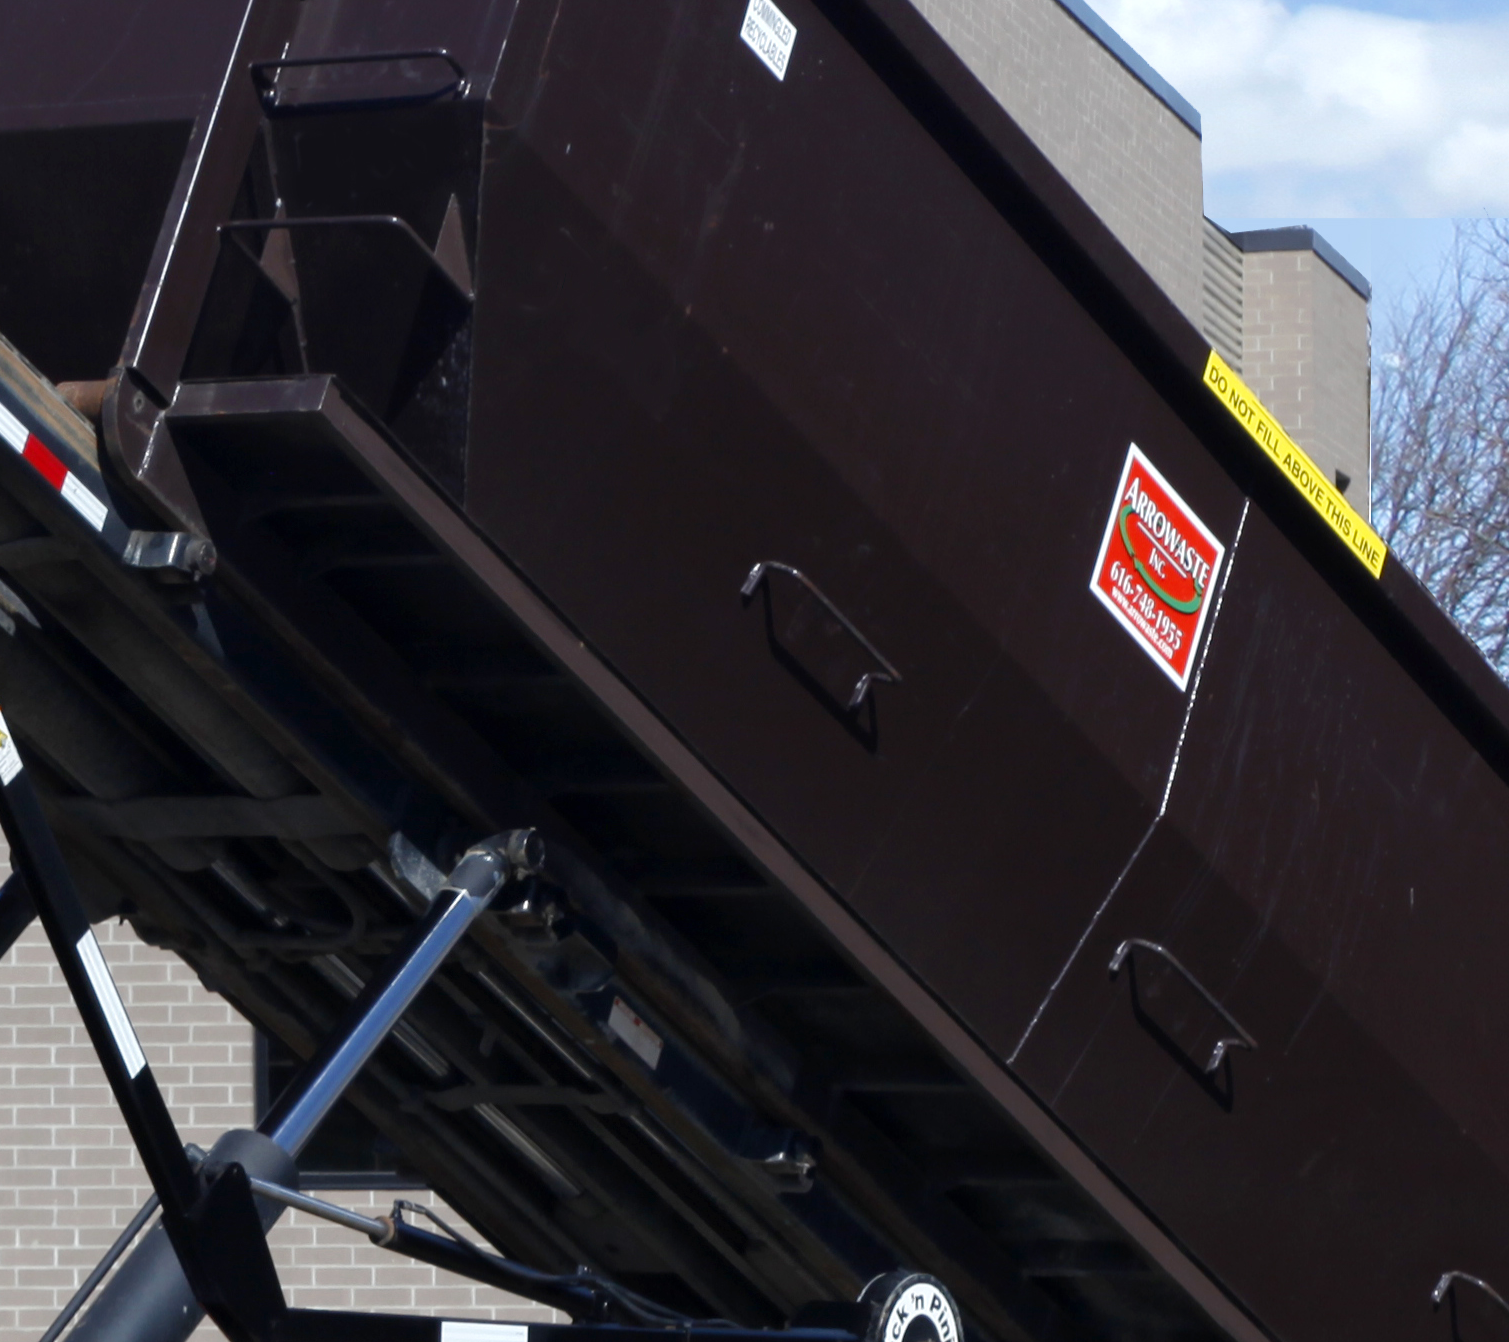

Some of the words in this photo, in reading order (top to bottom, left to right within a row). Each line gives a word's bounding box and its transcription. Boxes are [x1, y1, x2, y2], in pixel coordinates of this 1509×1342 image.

[744, 15, 786, 72] RECYCLABLES
[1209, 365, 1228, 394] DO
[1229, 388, 1255, 425] NOT
[1255, 420, 1280, 459] FILL
[1282, 453, 1324, 507] ABOVE
[1325, 497, 1351, 537] THIS
[1352, 529, 1380, 567] LINE
[1125, 477, 1210, 589] ARROWASTE
[1110, 560, 1183, 650] 616-748-1955
[1111, 585, 1174, 660] www.arrowaste.com
